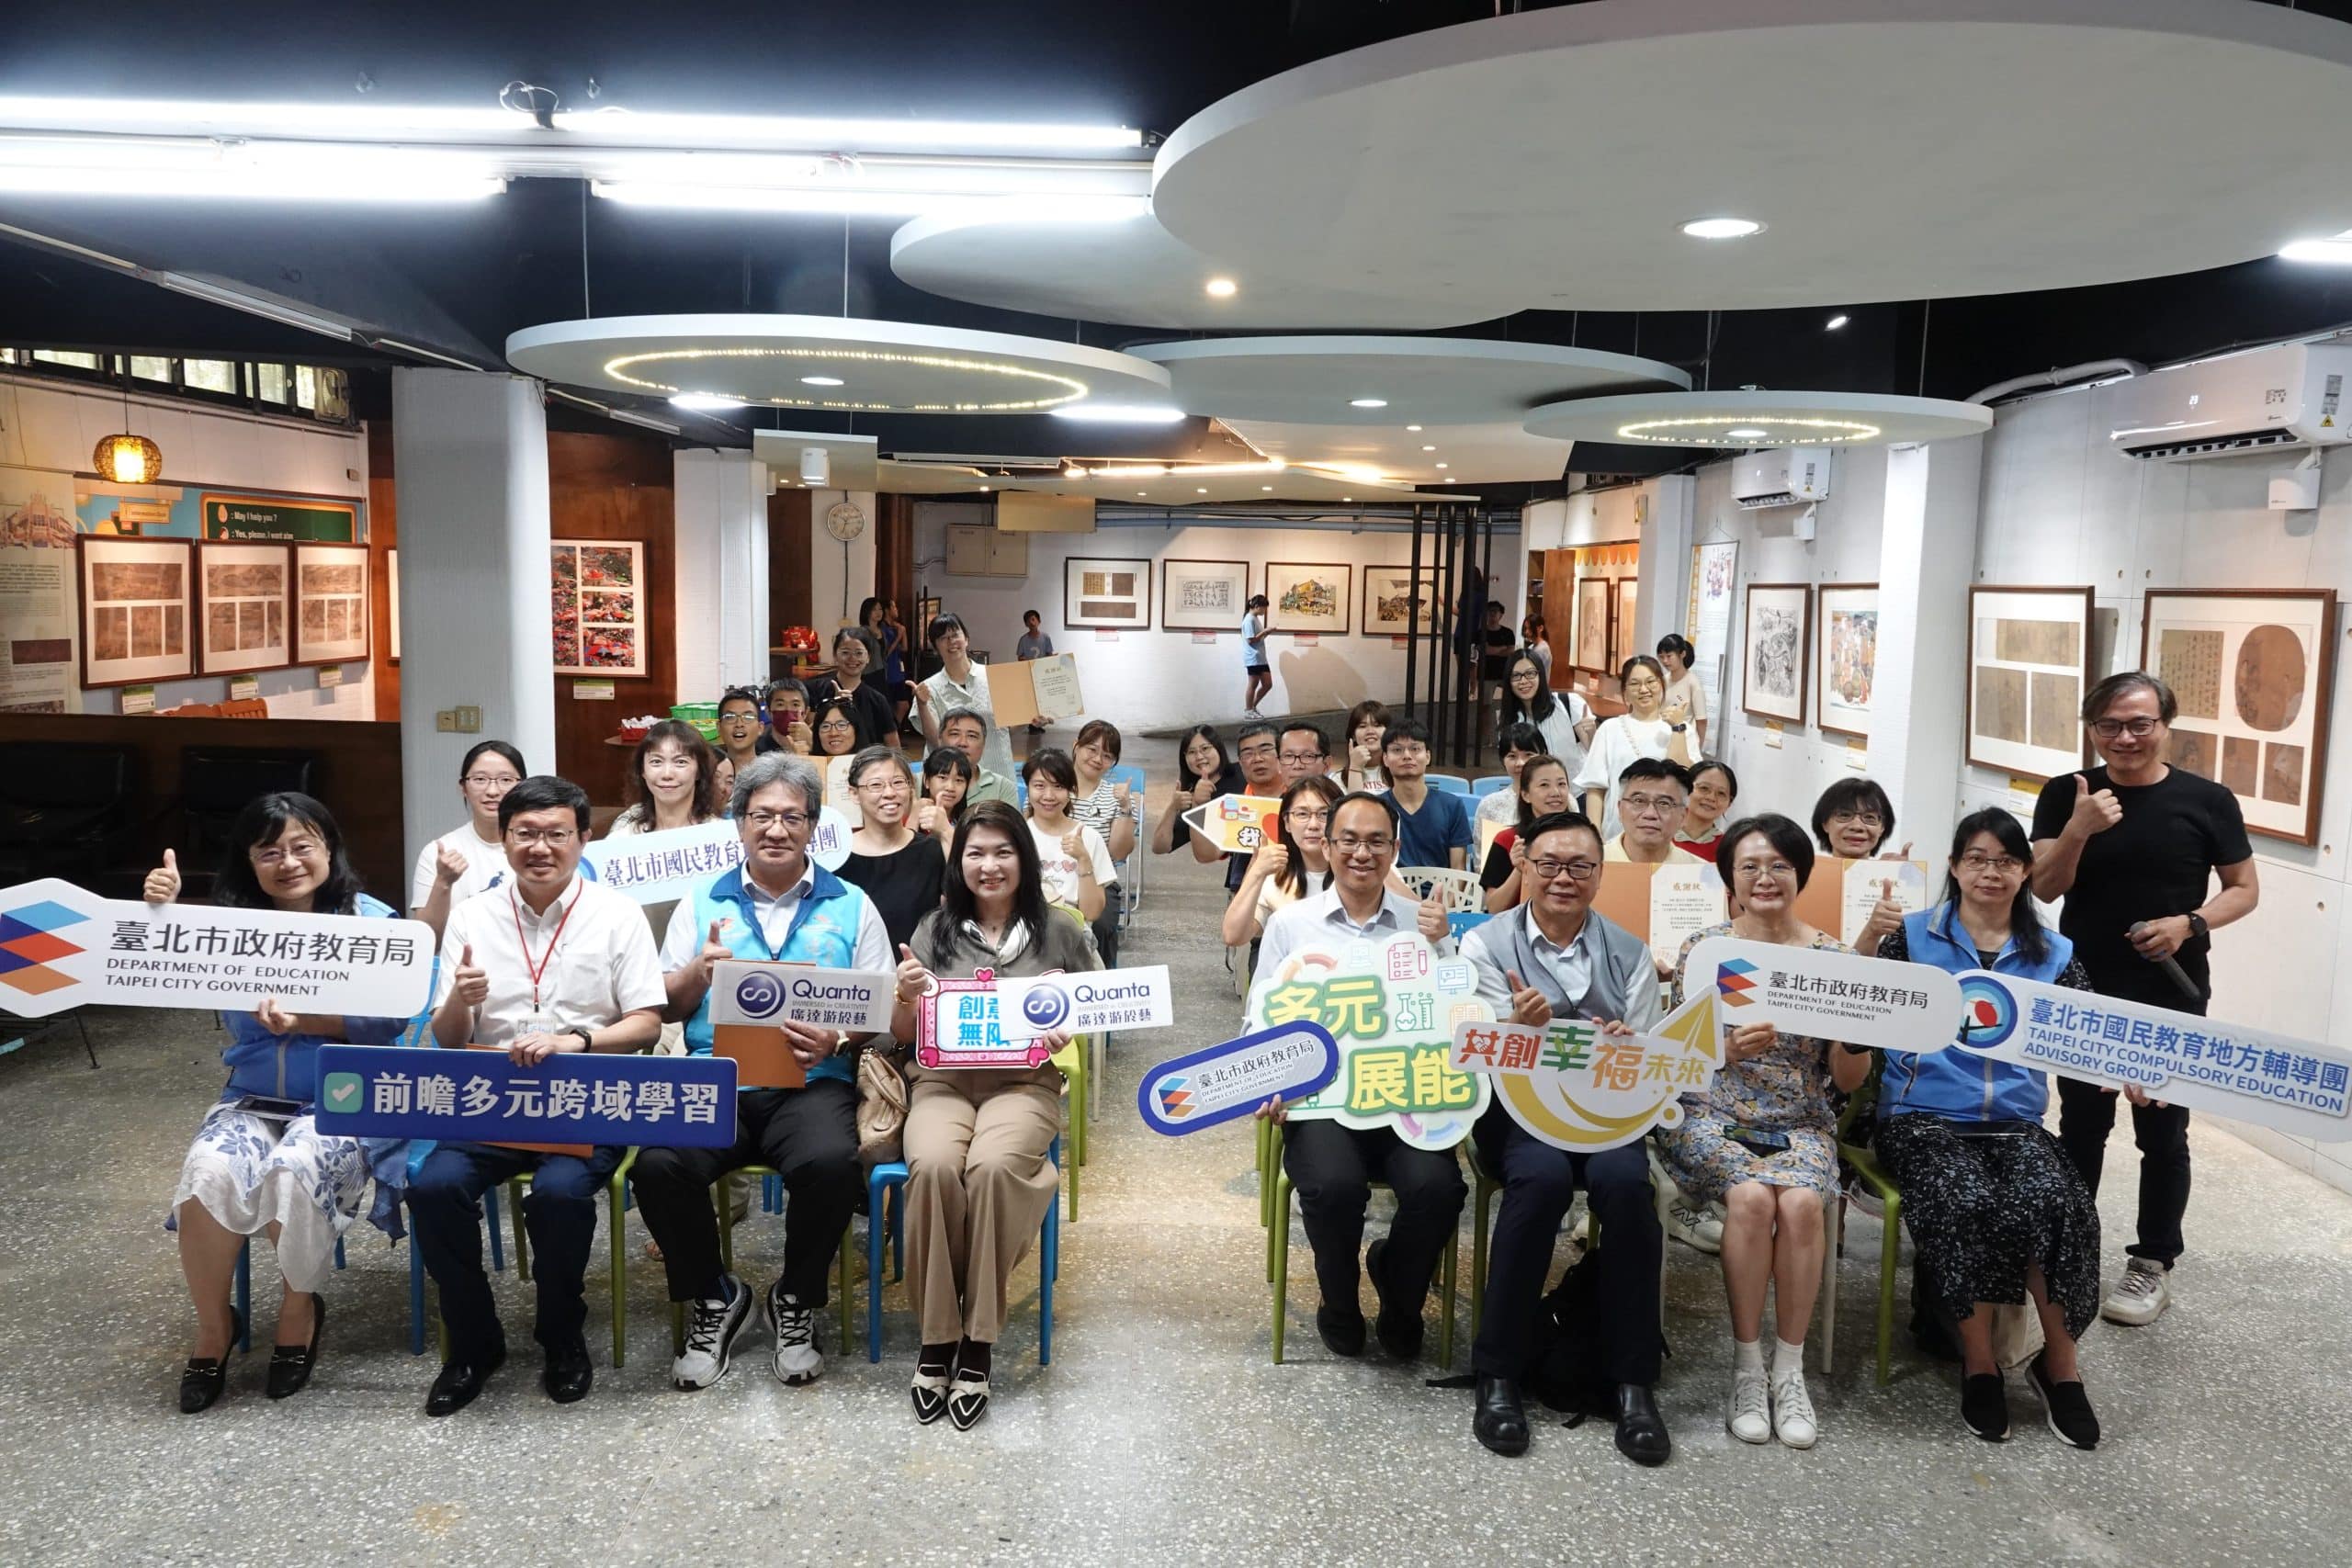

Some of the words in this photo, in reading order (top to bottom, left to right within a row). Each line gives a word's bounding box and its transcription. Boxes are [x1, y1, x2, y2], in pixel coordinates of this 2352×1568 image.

[109, 919, 415, 967] 臺北市政府教育局
[107, 958, 220, 976] DEPARTMENT
[224, 964, 246, 976] OF
[254, 965, 350, 982] EDUCATION
[105, 975, 157, 988] TAIPEI
[162, 977, 203, 990] CITY
[206, 979, 322, 996] GOVERNMENT
[792, 978, 871, 1001] Quanta
[1074, 981, 1150, 1003] Quanta
[1769, 970, 1928, 1010] 臺北市政府教育局
[1767, 990, 1822, 1005] DEPARTMENT
[1825, 998, 1836, 1007] OF
[1840, 1001, 1893, 1015] EDUCATION
[1767, 999, 1792, 1010] TAIPEI
[1794, 1002, 1815, 1012] CITY
[1816, 1007, 1875, 1021] GOVERNMENT
[2030, 997, 2350, 1095] 臺北市國民教育地方輔導團
[1198, 1040, 1315, 1089] 臺北市政府教育局
[2024, 1042, 2103, 1070] ADVISORY
[2104, 1061, 2164, 1086] GROUP
[2029, 1026, 2077, 1052] TAIPEI
[2080, 1039, 2115, 1059] CITY
[2117, 1045, 2234, 1087] COMPULSORY
[2235, 1074, 2344, 1112] EDUCATION
[1202, 1080, 1242, 1097] DEPARTMENT
[1240, 1074, 1284, 1093] GOVERNMENT
[373, 1071, 719, 1124] 前瞻多元跨域學習
